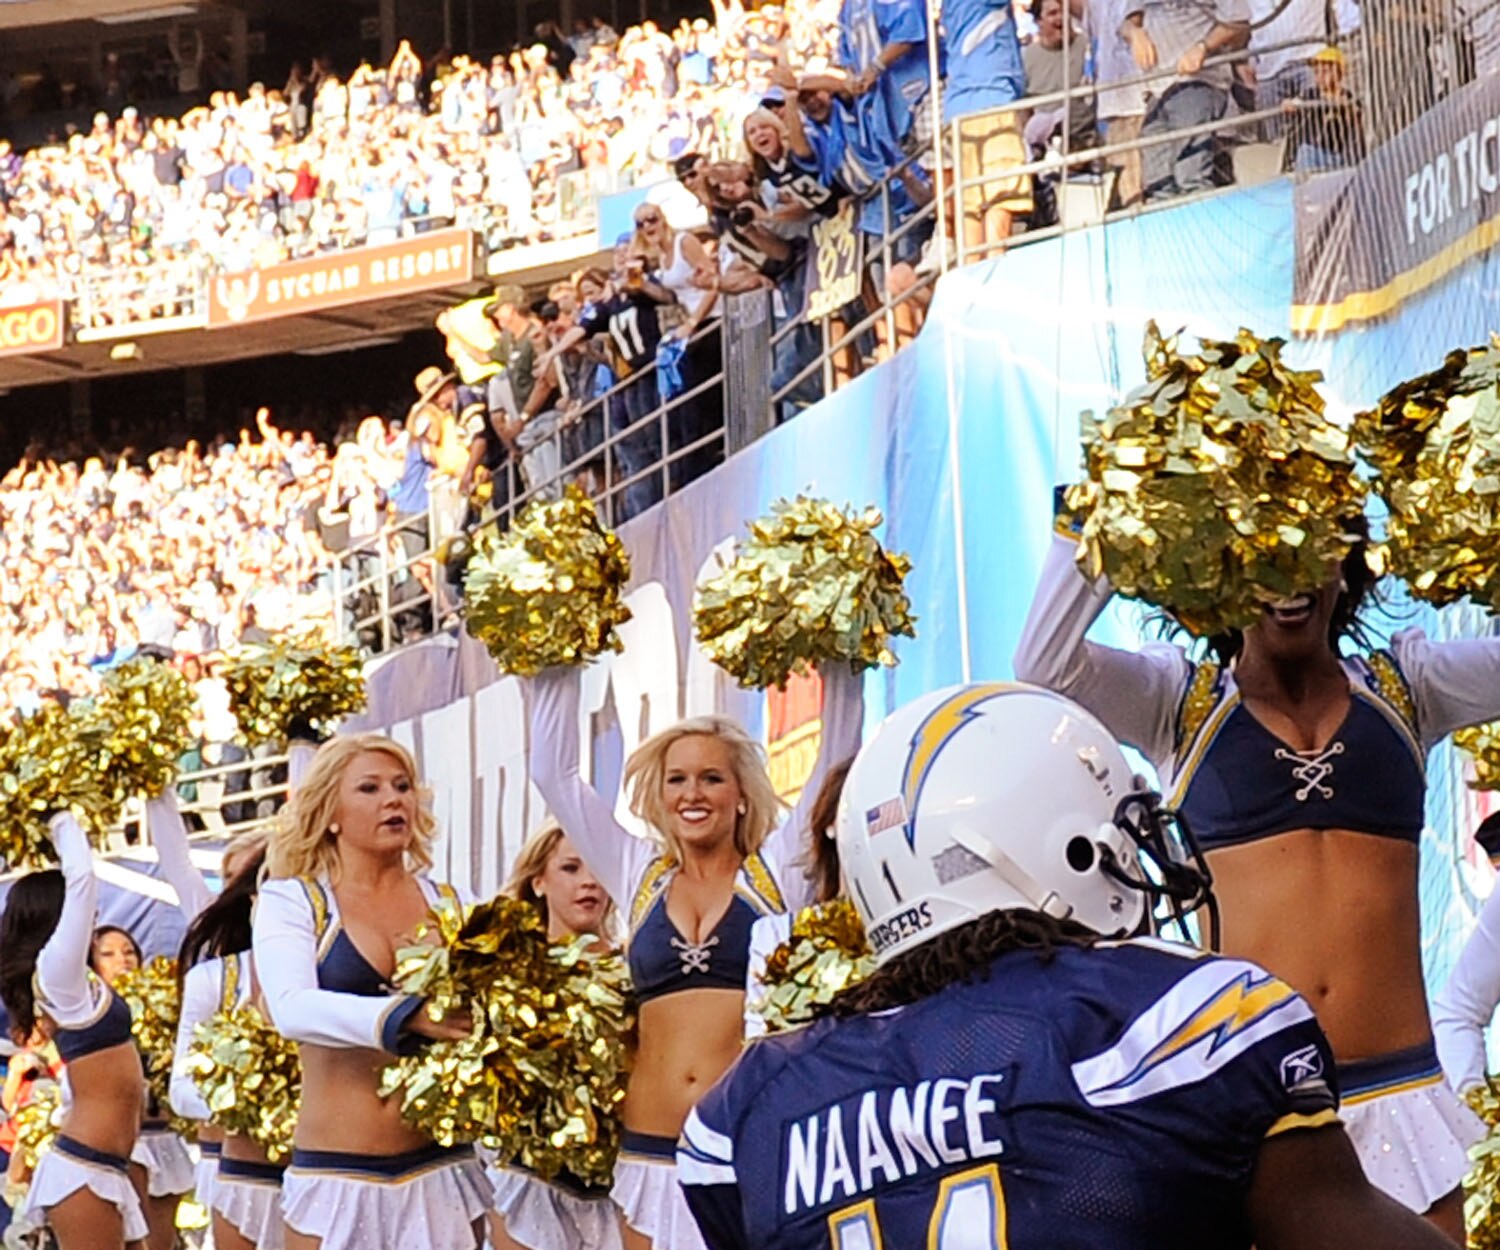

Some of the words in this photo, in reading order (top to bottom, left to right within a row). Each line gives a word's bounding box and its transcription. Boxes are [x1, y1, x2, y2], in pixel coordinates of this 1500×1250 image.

[1404, 152, 1453, 245] FOR
[266, 263, 360, 304] SYCUAN
[370, 244, 465, 286] RESORT
[608, 305, 646, 361] 17
[784, 1073, 1004, 1214] NAANEE
